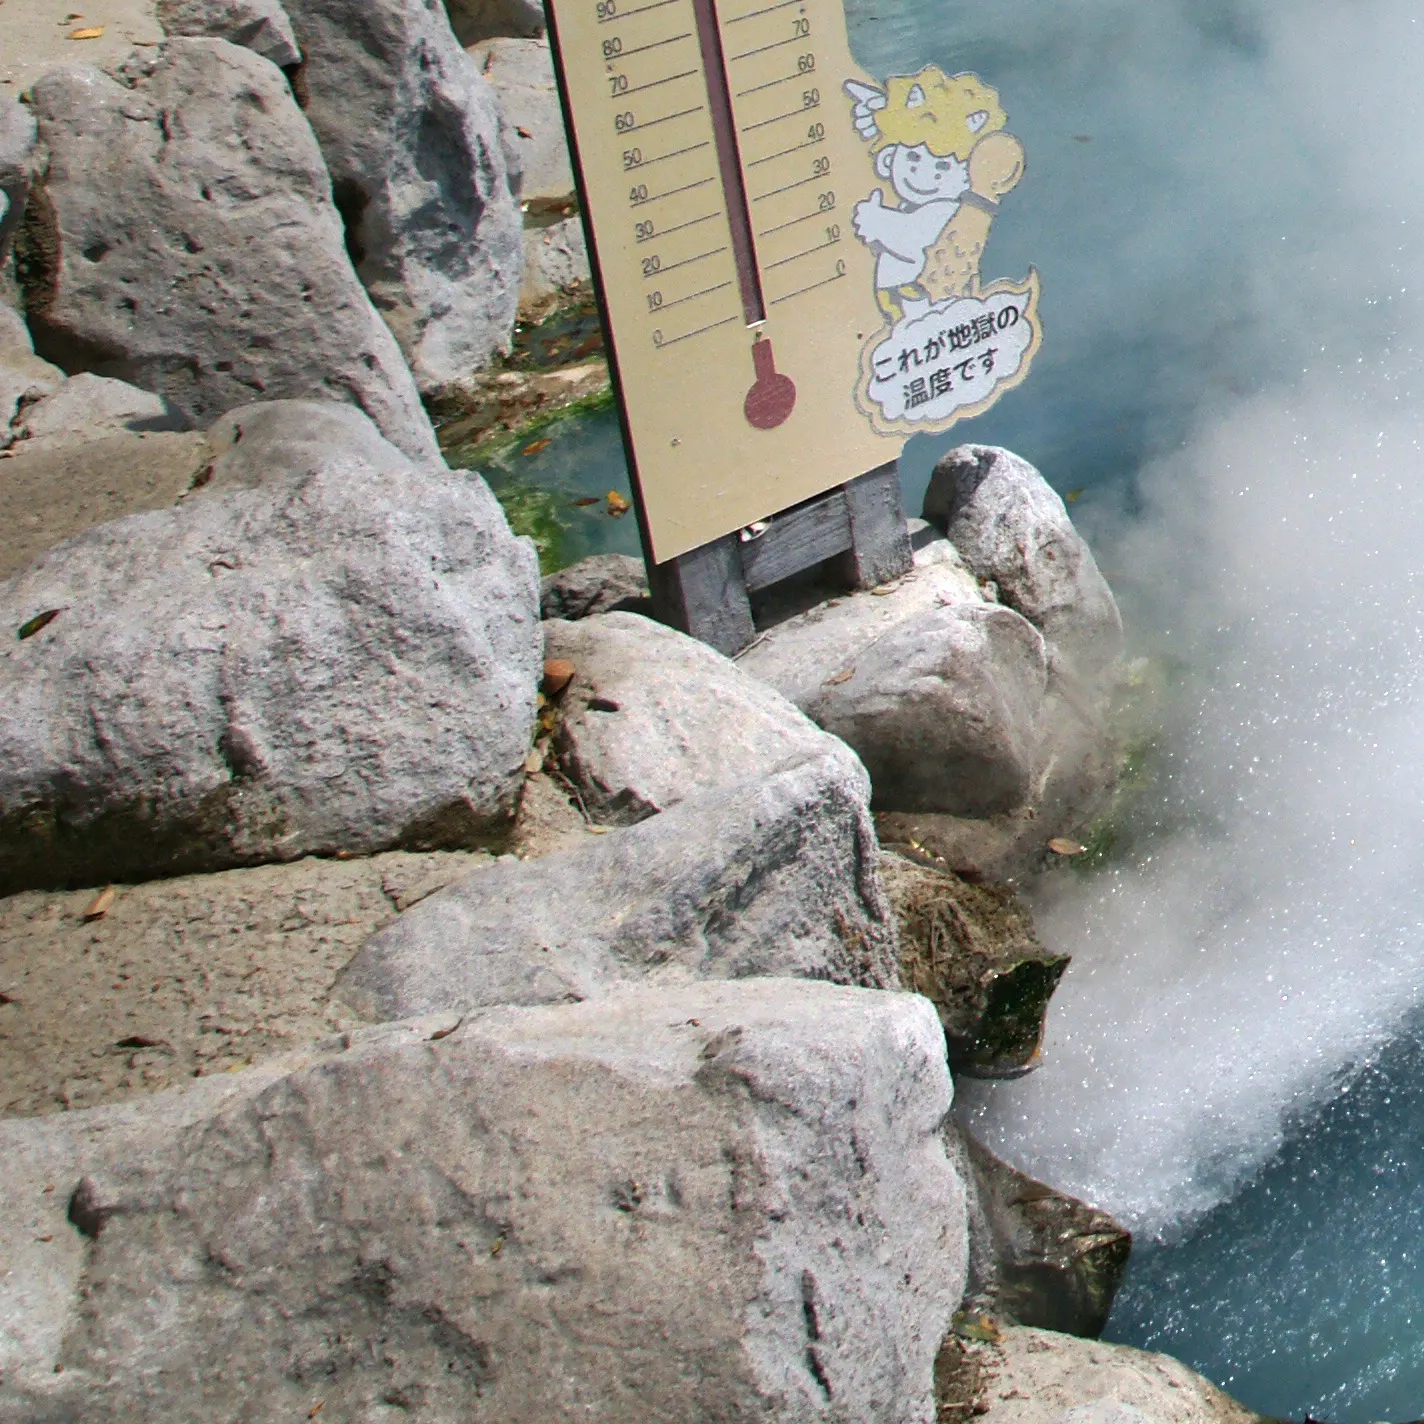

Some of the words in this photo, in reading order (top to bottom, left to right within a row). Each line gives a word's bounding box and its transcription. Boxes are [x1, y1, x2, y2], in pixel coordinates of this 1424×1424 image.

[596, 0, 616, 18] 90
[792, 18, 810, 36] 70
[602, 37, 622, 56] 80
[797, 53, 815, 71] 60
[608, 74, 628, 94] 70
[803, 88, 820, 106] 50
[615, 111, 634, 130] 60
[807, 122, 825, 140] 40
[623, 147, 642, 167] 50
[813, 156, 830, 174] 30
[629, 184, 648, 203] 40
[818, 191, 835, 209] 20
[635, 219, 654, 239] 30
[826, 224, 841, 241] 10
[641, 255, 661, 274] 20
[835, 259, 846, 276] 0
[647, 290, 663, 310] 10
[652, 329, 663, 345] 0
[875, 305, 1019, 383] これが地獄の
[903, 348, 998, 410] 温度です
